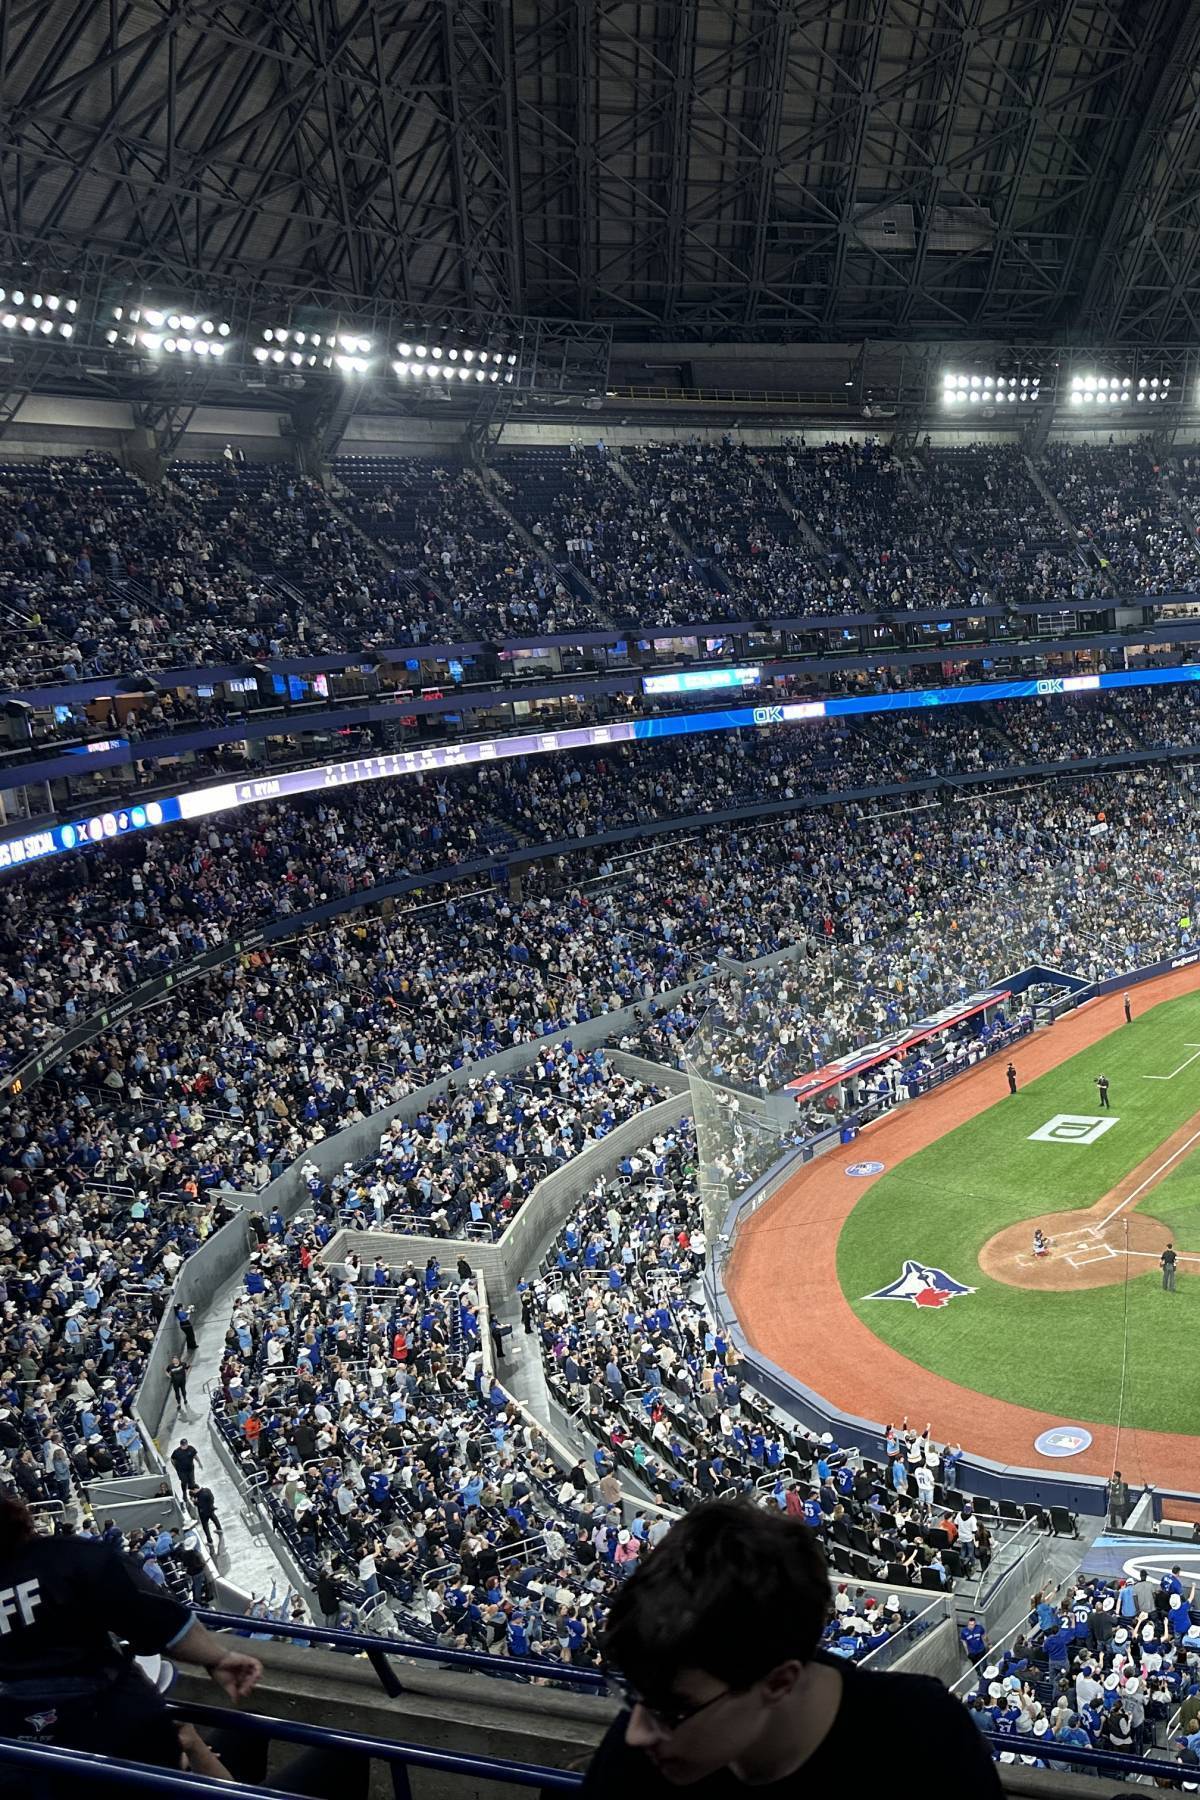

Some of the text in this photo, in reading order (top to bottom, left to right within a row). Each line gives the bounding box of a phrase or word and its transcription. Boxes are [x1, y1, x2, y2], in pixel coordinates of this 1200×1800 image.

[1036, 678, 1063, 695] OK
[753, 705, 783, 724] OK
[1061, 1616, 1069, 1629] 2
[1075, 1610, 1088, 1623] 10
